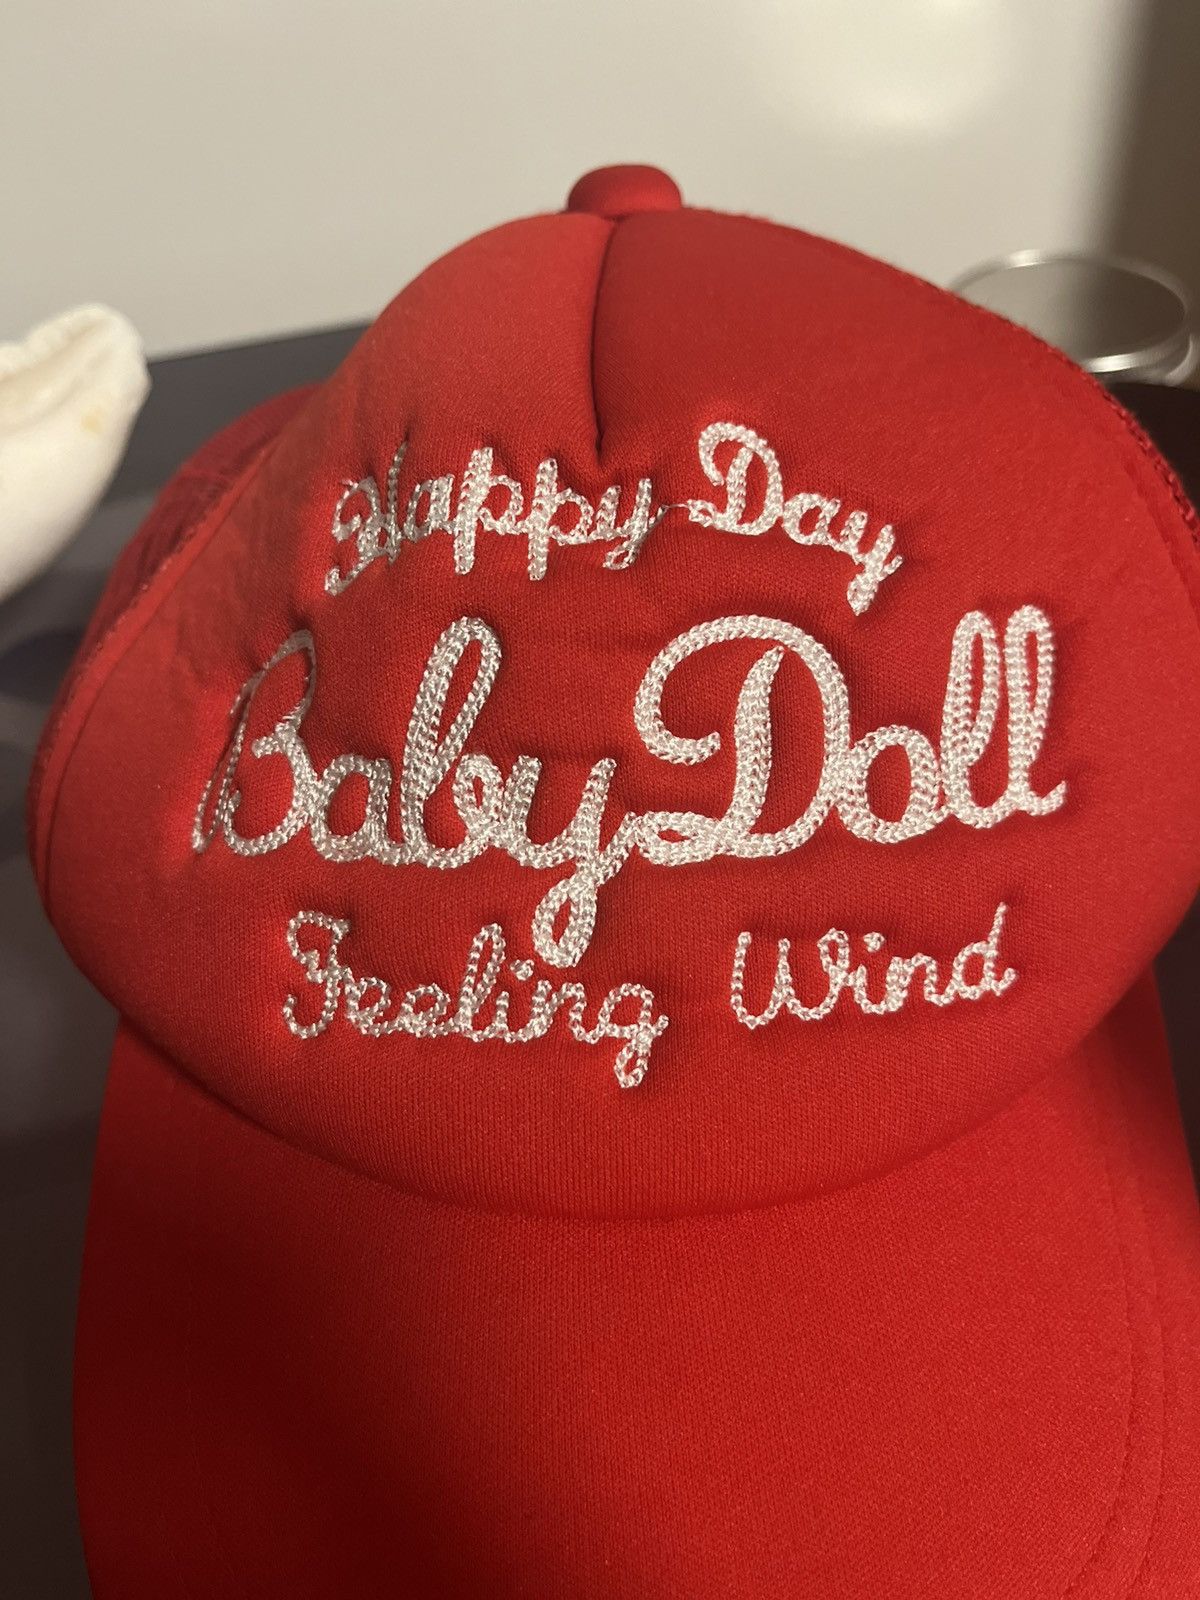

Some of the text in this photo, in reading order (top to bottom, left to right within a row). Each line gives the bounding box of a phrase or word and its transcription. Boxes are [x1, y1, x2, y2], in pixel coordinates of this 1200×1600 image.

[323, 421, 903, 616] Happy Day
[191, 604, 1067, 969] Baby Doll
[282, 903, 1018, 1089] Feeling Wind
